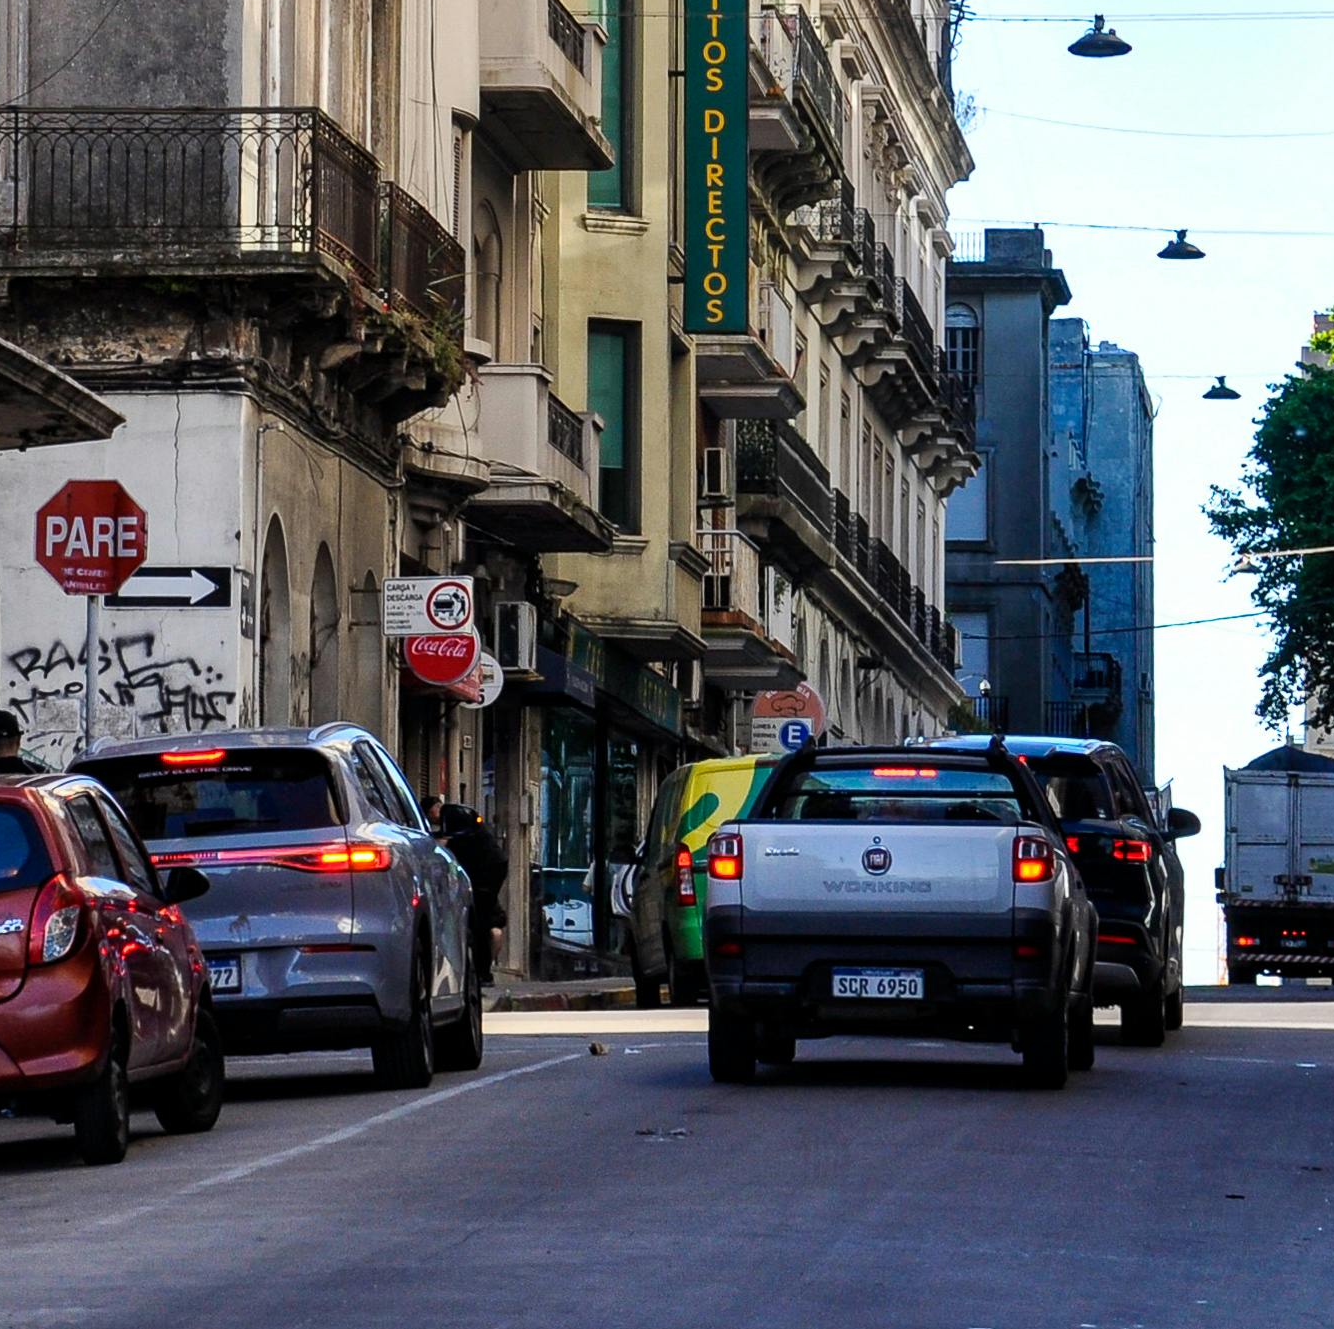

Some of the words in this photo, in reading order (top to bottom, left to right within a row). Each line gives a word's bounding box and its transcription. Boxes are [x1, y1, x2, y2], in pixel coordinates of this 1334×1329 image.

[703, 109, 726, 324] DIRECTOS
[45, 516, 138, 558] PARE
[787, 724, 802, 744] E
[822, 880, 932, 894] WORKING
[838, 977, 869, 995] SCR
[877, 978, 917, 996] 6950
